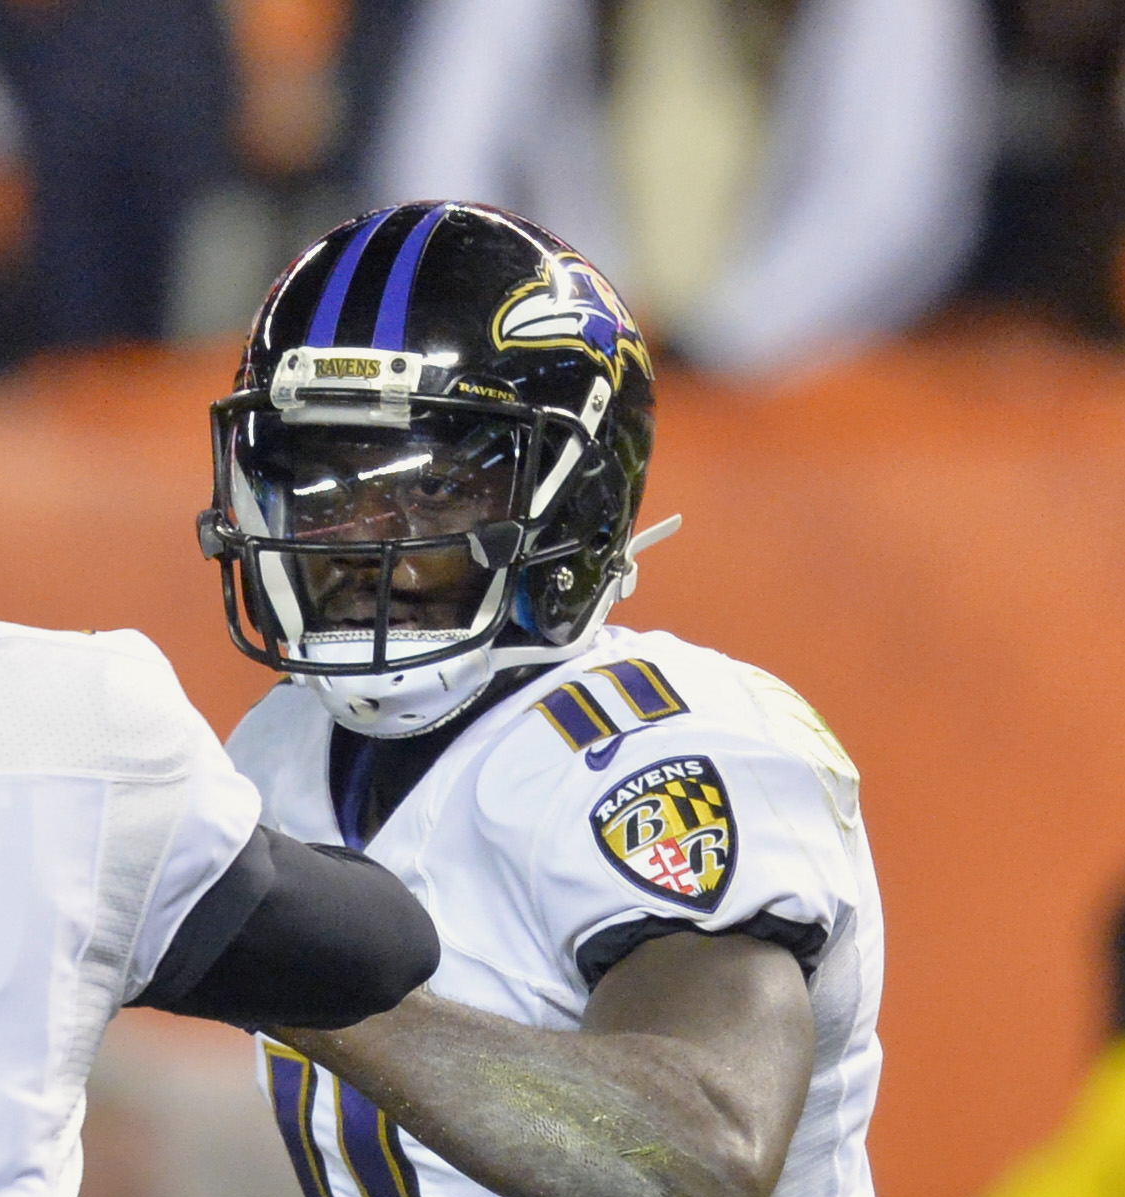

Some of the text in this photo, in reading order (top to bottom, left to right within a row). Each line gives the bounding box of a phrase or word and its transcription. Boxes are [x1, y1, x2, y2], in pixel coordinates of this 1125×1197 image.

[313, 357, 382, 379] RAVENS
[458, 381, 517, 402] RAVENS
[524, 657, 691, 753] 11
[595, 760, 704, 823] RAVENS
